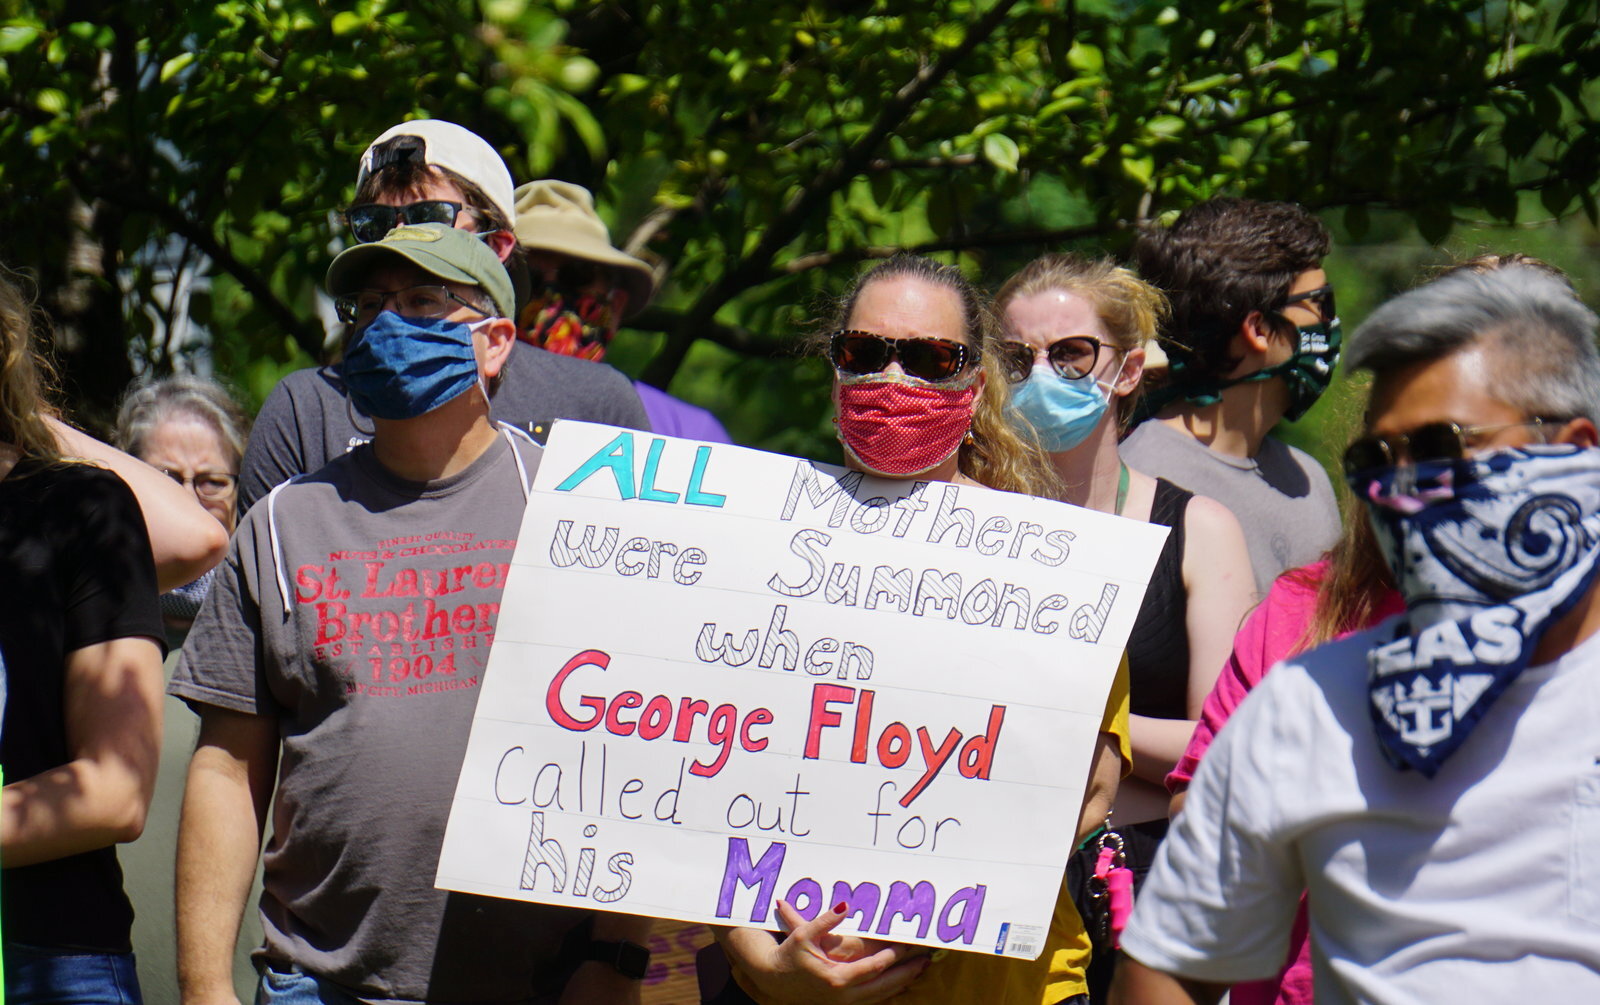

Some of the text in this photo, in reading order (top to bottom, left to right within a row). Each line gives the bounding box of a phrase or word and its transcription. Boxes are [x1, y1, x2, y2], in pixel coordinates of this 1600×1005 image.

[554, 431, 1077, 567] ALL Mothers
[328, 550, 377, 562] NUTS
[381, 550, 396, 560] &
[377, 531, 477, 549] FINEST QUALITY
[295, 564, 351, 605] St.
[767, 528, 1120, 644] Summoned
[368, 652, 458, 684] 1904
[695, 605, 874, 681] when
[407, 675, 479, 697] MICHIGAN
[545, 649, 1007, 808] George Floyd
[727, 773, 811, 837] out
[867, 781, 962, 852] for
[519, 811, 987, 945] his Momma
